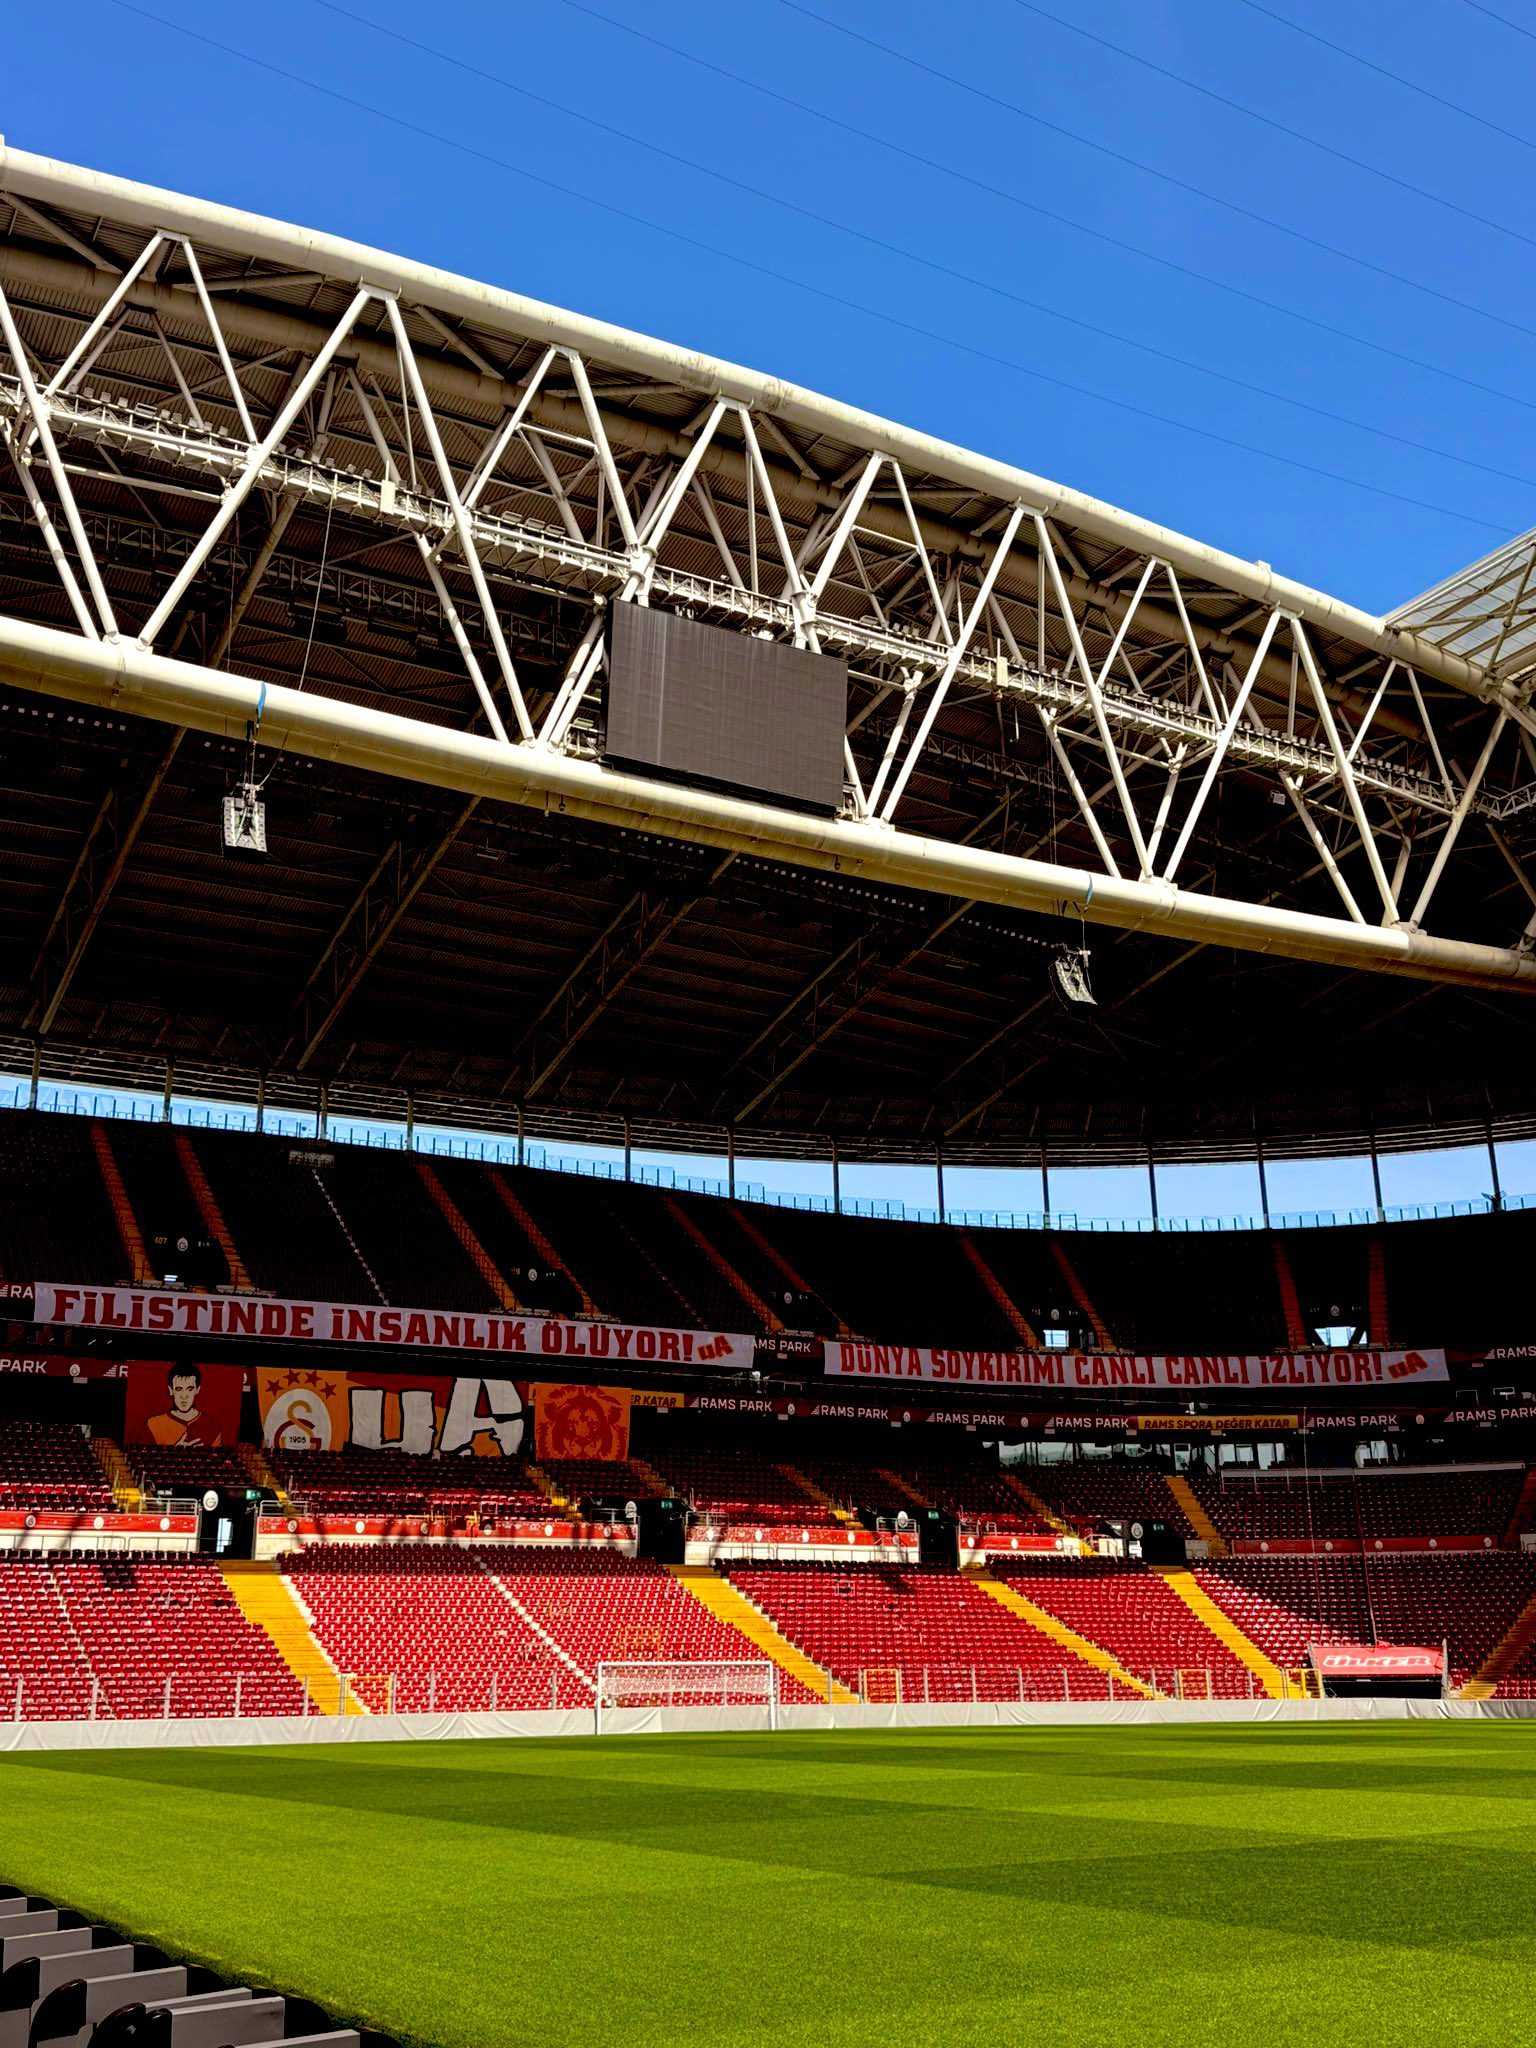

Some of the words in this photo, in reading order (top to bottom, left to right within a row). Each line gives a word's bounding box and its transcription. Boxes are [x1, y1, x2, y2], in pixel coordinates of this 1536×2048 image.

[10, 1285, 33, 1299] RA
[541, 1321, 693, 1361] ÖLÜYOR!
[753, 1338, 776, 1350] AMS
[779, 1340, 811, 1353] PARK
[1496, 1345, 1536, 1359] RAMS
[0, 1359, 47, 1374] PARK
[840, 1343, 922, 1377] DÜNYA
[931, 1347, 1064, 1384] SOYKIRIMI
[1074, 1355, 1156, 1385] CANLI
[1165, 1355, 1249, 1385] CANLI
[643, 1394, 677, 1407] KATAR
[700, 1397, 736, 1410] RAMS
[739, 1399, 772, 1412] PARK
[821, 1404, 854, 1418] RAMS
[857, 1407, 889, 1420] PARK
[936, 1412, 969, 1424] RAMS
[972, 1413, 1006, 1426] PARK
[1455, 1410, 1496, 1422] RAMS
[1500, 1407, 1536, 1419] PARK
[1055, 1417, 1092, 1428] RAMS
[1095, 1417, 1129, 1428] PARK
[1144, 1420, 1175, 1429] RAMS
[1254, 1418, 1290, 1428] KATAR
[1316, 1416, 1356, 1427] RAMS
[1360, 1415, 1397, 1426] PARK
